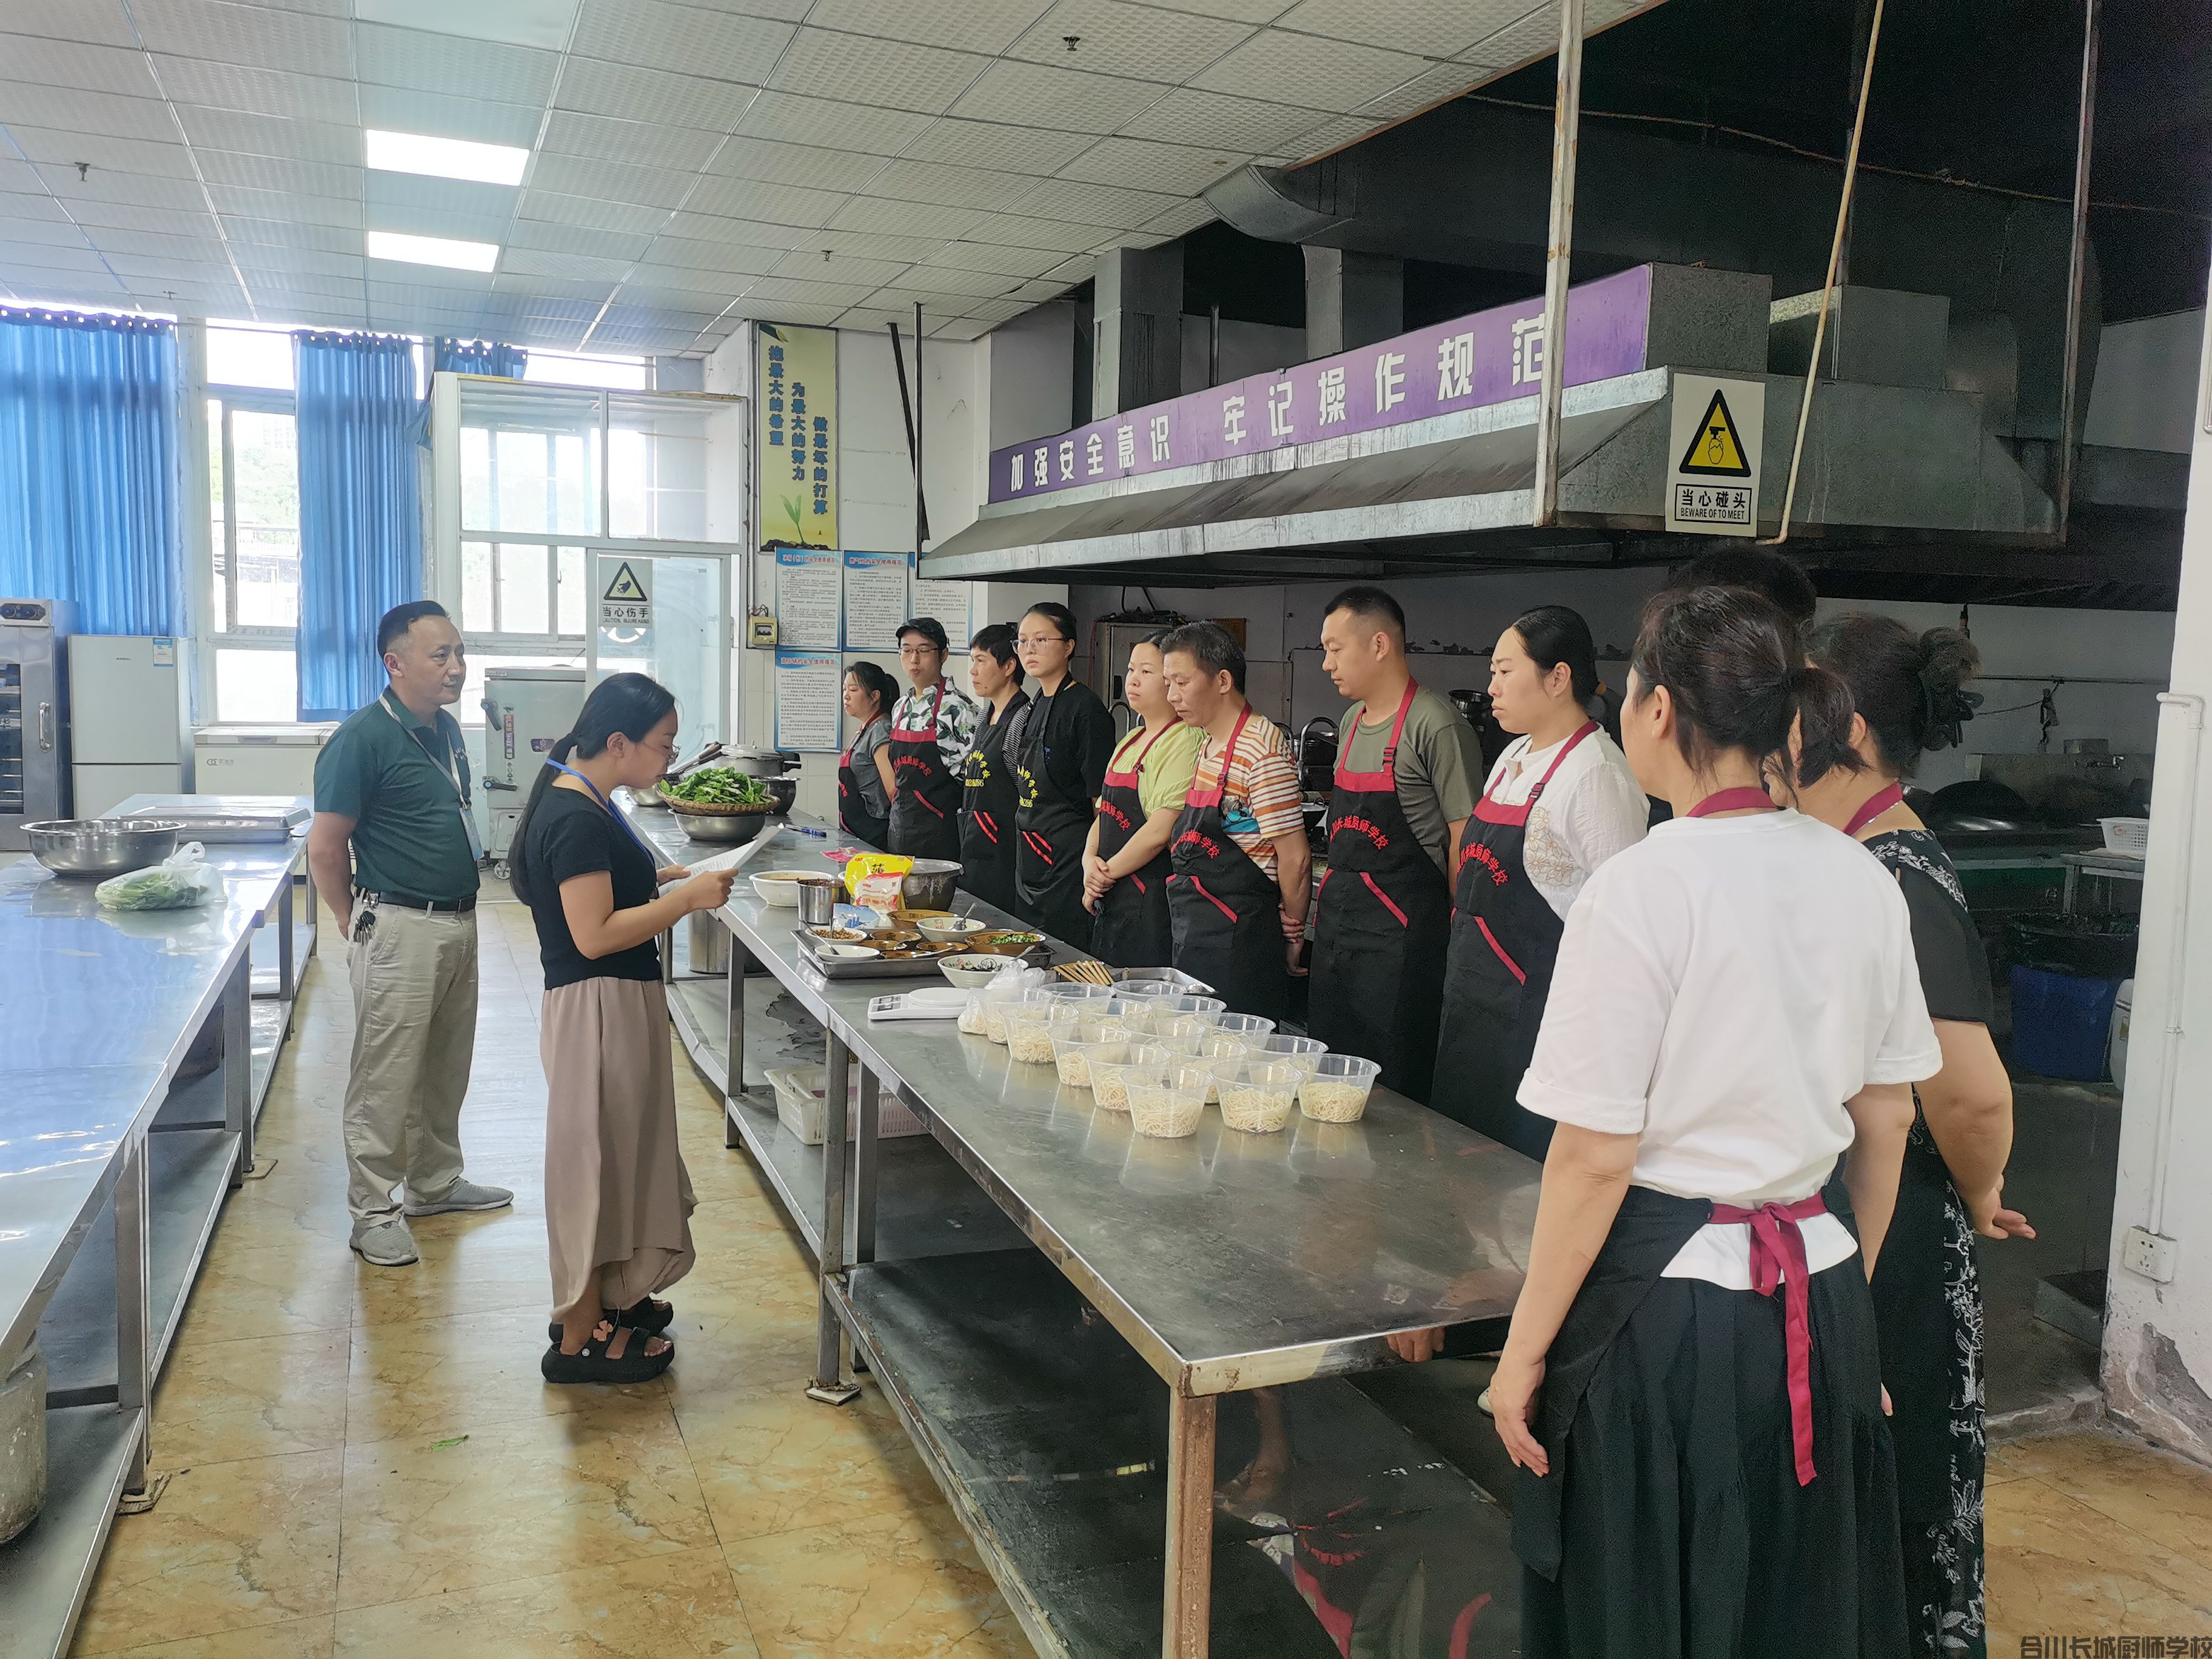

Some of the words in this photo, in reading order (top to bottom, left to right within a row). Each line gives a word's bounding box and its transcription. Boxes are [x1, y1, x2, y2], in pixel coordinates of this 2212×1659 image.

[1011, 415, 1170, 492] 加强安全意识
[1223, 313, 1545, 446] 牢记操作规范
[791, 382, 806, 481] 为最大的努力
[813, 417, 828, 515] 做最坏的打算
[1680, 508, 1708, 518] BEWARE
[1709, 509, 1717, 518] OF
[1718, 509, 1727, 518] TO
[1728, 510, 1745, 520] MEET
[1681, 489, 1746, 509] 当心碰头
[602, 606, 649, 618] 当心伤手
[1457, 842, 1509, 886] 川长城厨师学校
